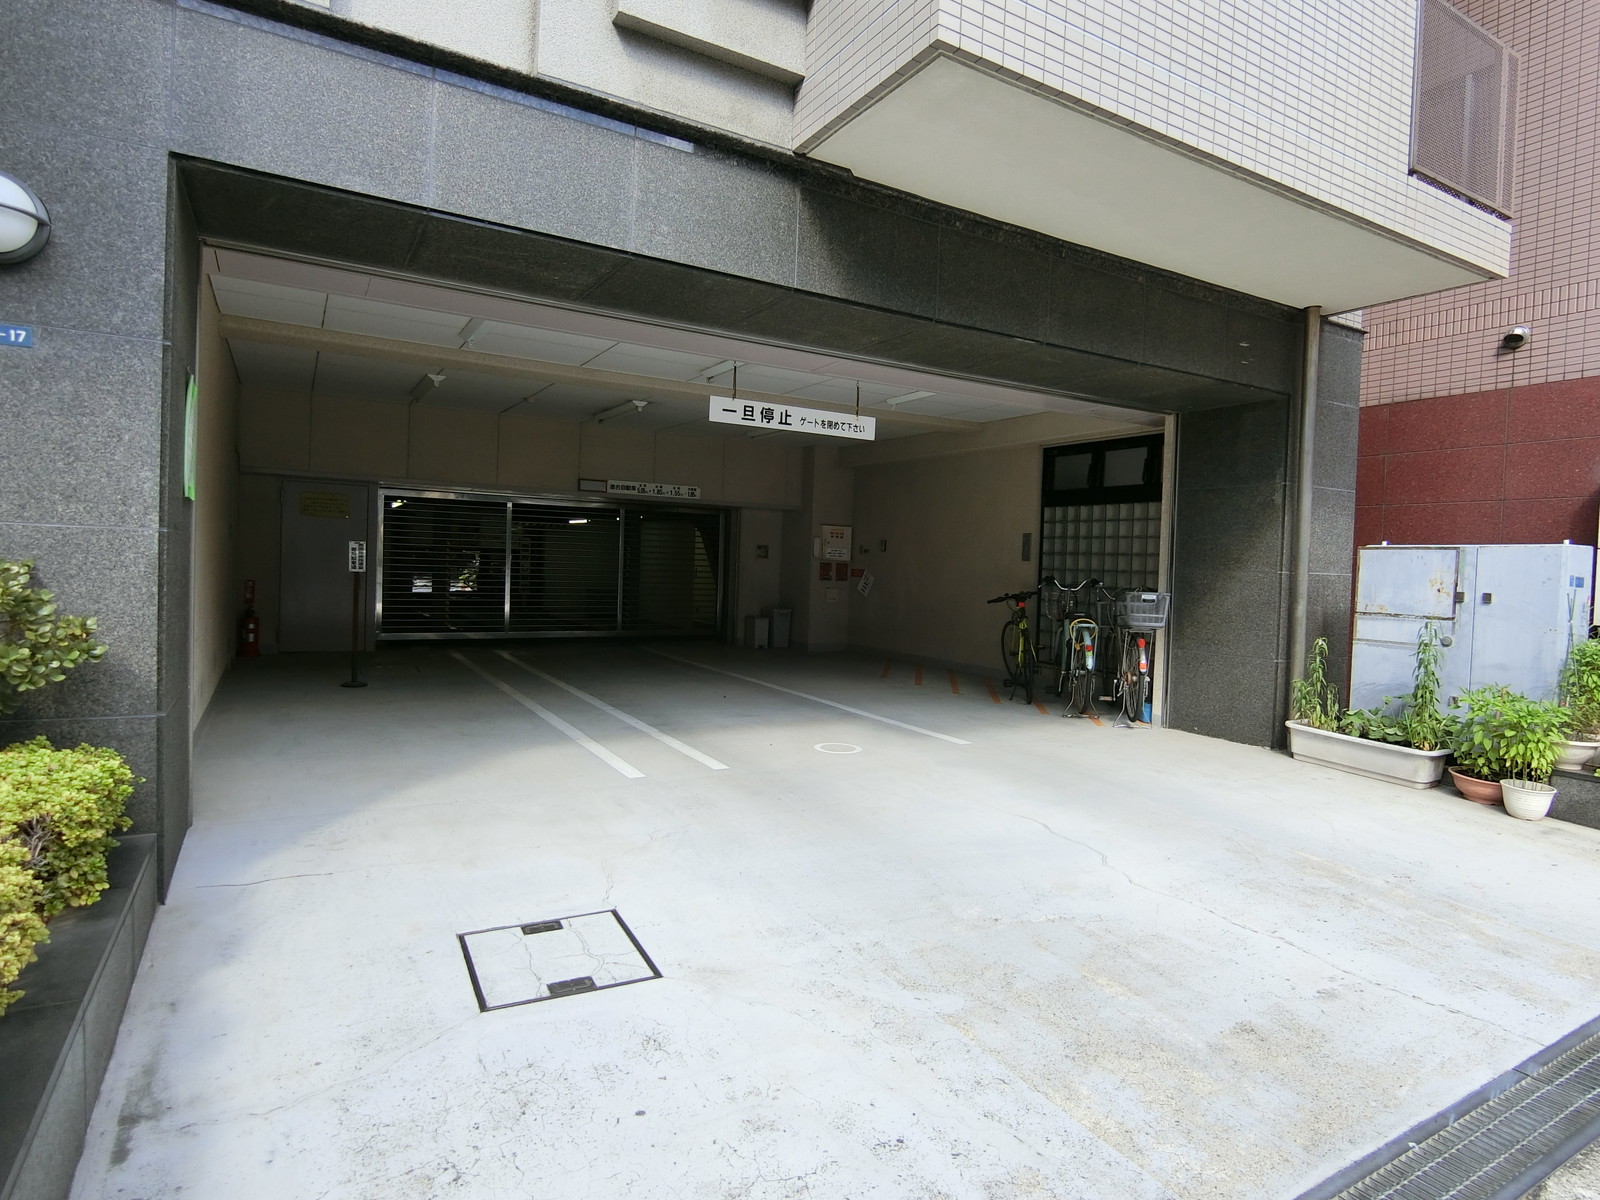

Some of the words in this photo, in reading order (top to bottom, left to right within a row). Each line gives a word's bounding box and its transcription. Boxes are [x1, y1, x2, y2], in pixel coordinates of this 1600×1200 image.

[722, 404, 792, 427] 一旦停止
[799, 416, 866, 433] ゲートを閉めて下さい
